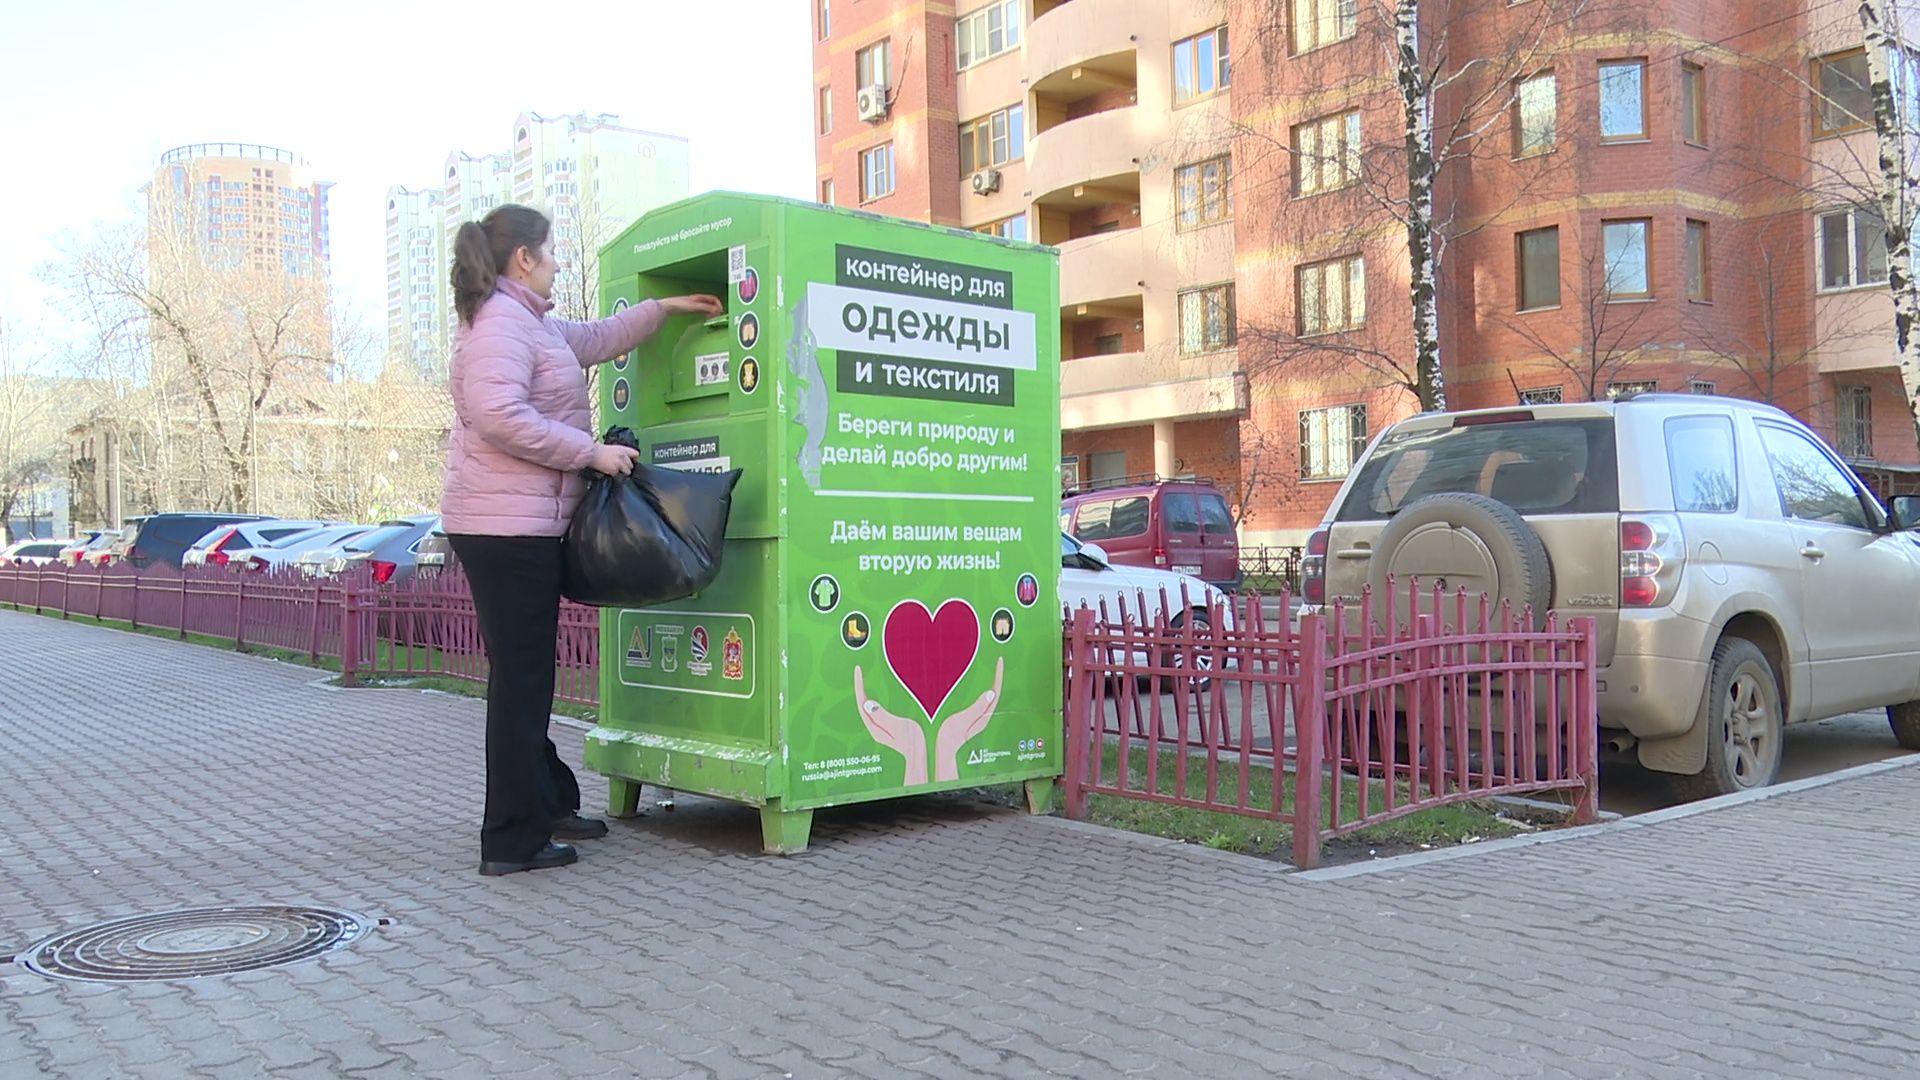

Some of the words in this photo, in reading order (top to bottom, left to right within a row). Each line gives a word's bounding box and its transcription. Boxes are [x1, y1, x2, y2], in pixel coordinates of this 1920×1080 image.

[633, 236, 670, 254] Пожалуйста
[671, 233, 679, 243] не
[711, 217, 732, 231] мусор
[846, 257, 963, 296] контейнер
[968, 277, 1005, 299] для
[841, 302, 1010, 352] одежды
[855, 361, 872, 384] и
[881, 363, 1000, 395] текстиля
[838, 412, 912, 440] Береги
[918, 421, 999, 447] природу
[1003, 427, 1015, 443] и
[654, 444, 698, 459] контейнер
[699, 442, 716, 455] для
[822, 444, 887, 466] делай
[891, 446, 953, 472] добро
[957, 453, 1028, 474] другим!
[830, 520, 886, 544] Даём
[892, 524, 958, 541] вашим
[963, 525, 1022, 543] вещам
[859, 553, 931, 574] вторую
[936, 551, 1000, 571] жизнь!
